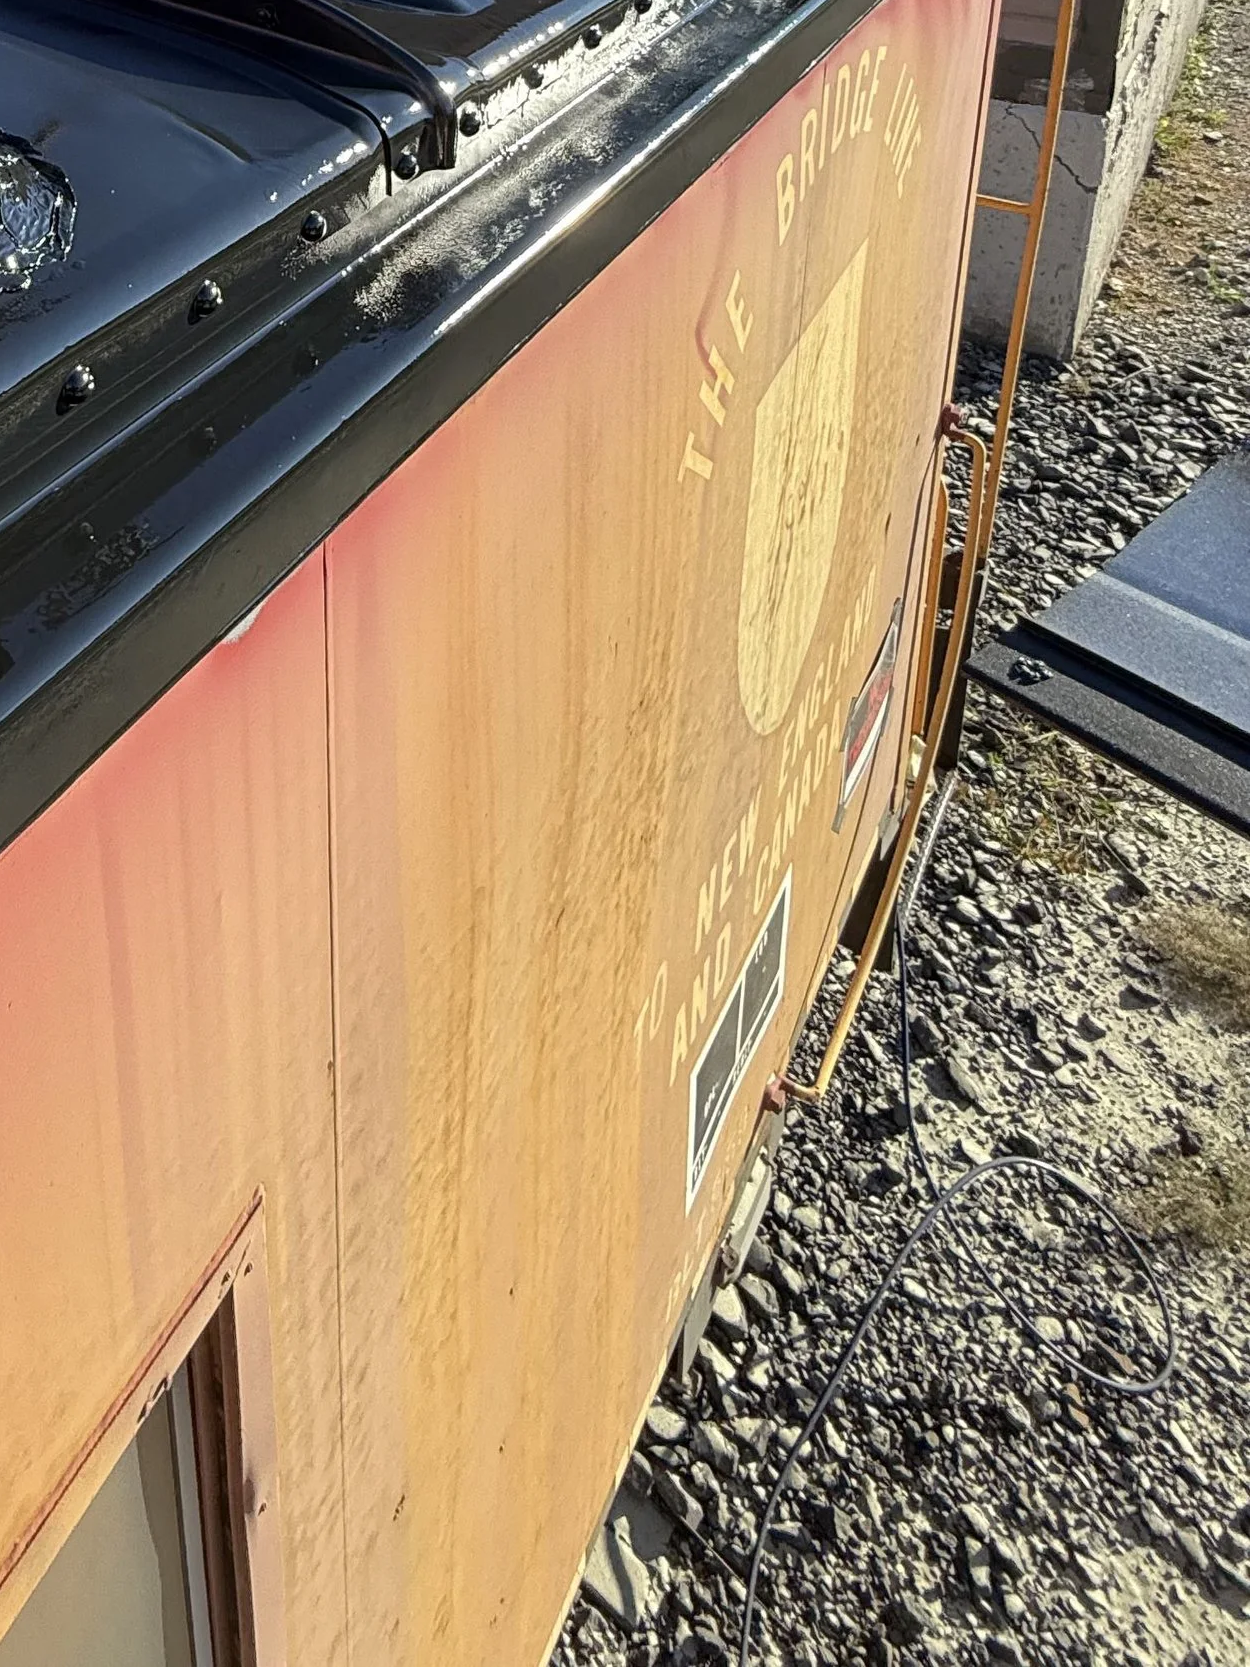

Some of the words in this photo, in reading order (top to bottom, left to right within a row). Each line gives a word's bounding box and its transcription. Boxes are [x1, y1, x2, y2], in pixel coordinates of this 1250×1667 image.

[676, 269, 754, 483] THE
[776, 45, 888, 247] BRIDGE
[884, 62, 922, 200] LINE
[634, 960, 668, 1075] TO
[695, 784, 762, 955] NEW
[778, 564, 877, 798] ENGLAND
[669, 921, 731, 1087] AND
[753, 699, 841, 915] CANADA
